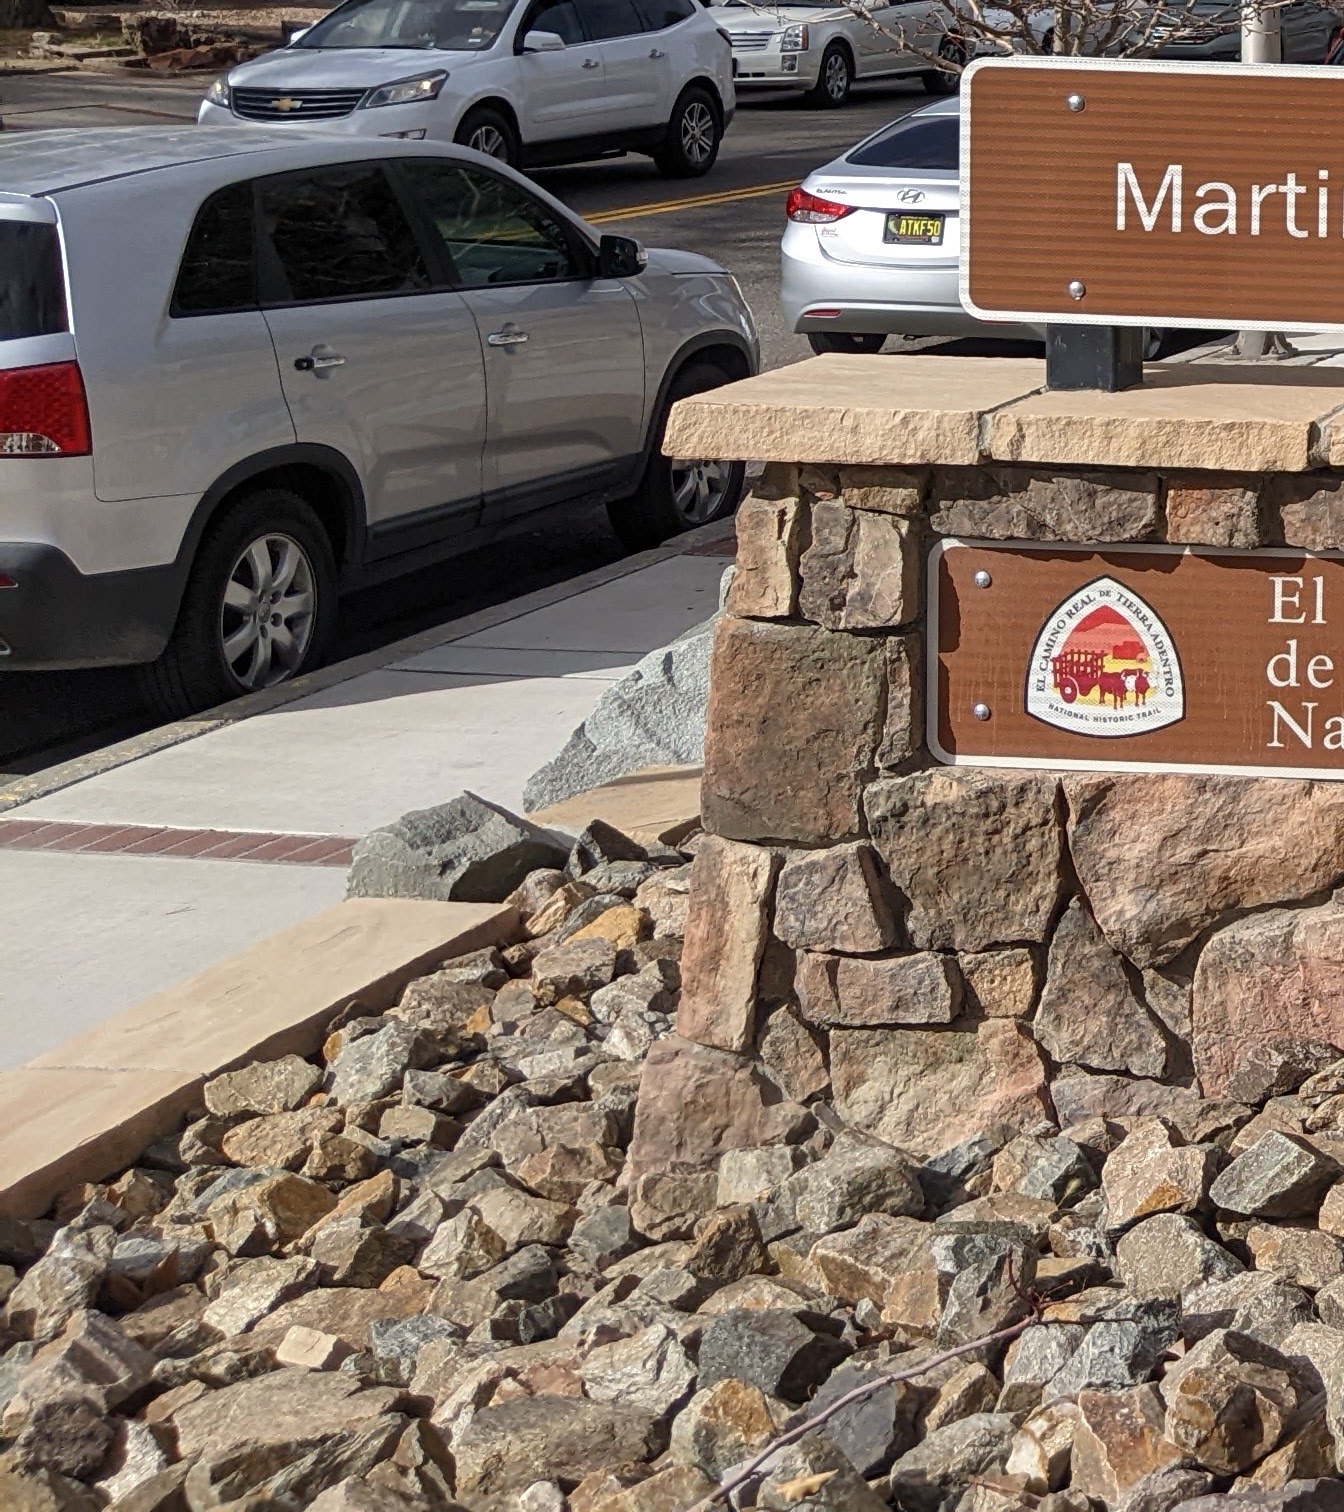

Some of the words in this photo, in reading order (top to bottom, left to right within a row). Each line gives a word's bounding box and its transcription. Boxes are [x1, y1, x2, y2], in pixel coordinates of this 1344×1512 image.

[1065, 594, 1097, 620] REAL
[1099, 590, 1112, 598] DE
[1115, 591, 1154, 632] TIERRA
[1267, 576, 1328, 626] El
[1039, 619, 1068, 672] CAMINO
[1150, 632, 1176, 698] ADENTRO
[1266, 639, 1335, 690] de
[1036, 675, 1047, 693] EL
[1047, 702, 1091, 722] NATIONAL
[1092, 714, 1135, 724] HISTORIC
[1136, 707, 1162, 721] TRAIL
